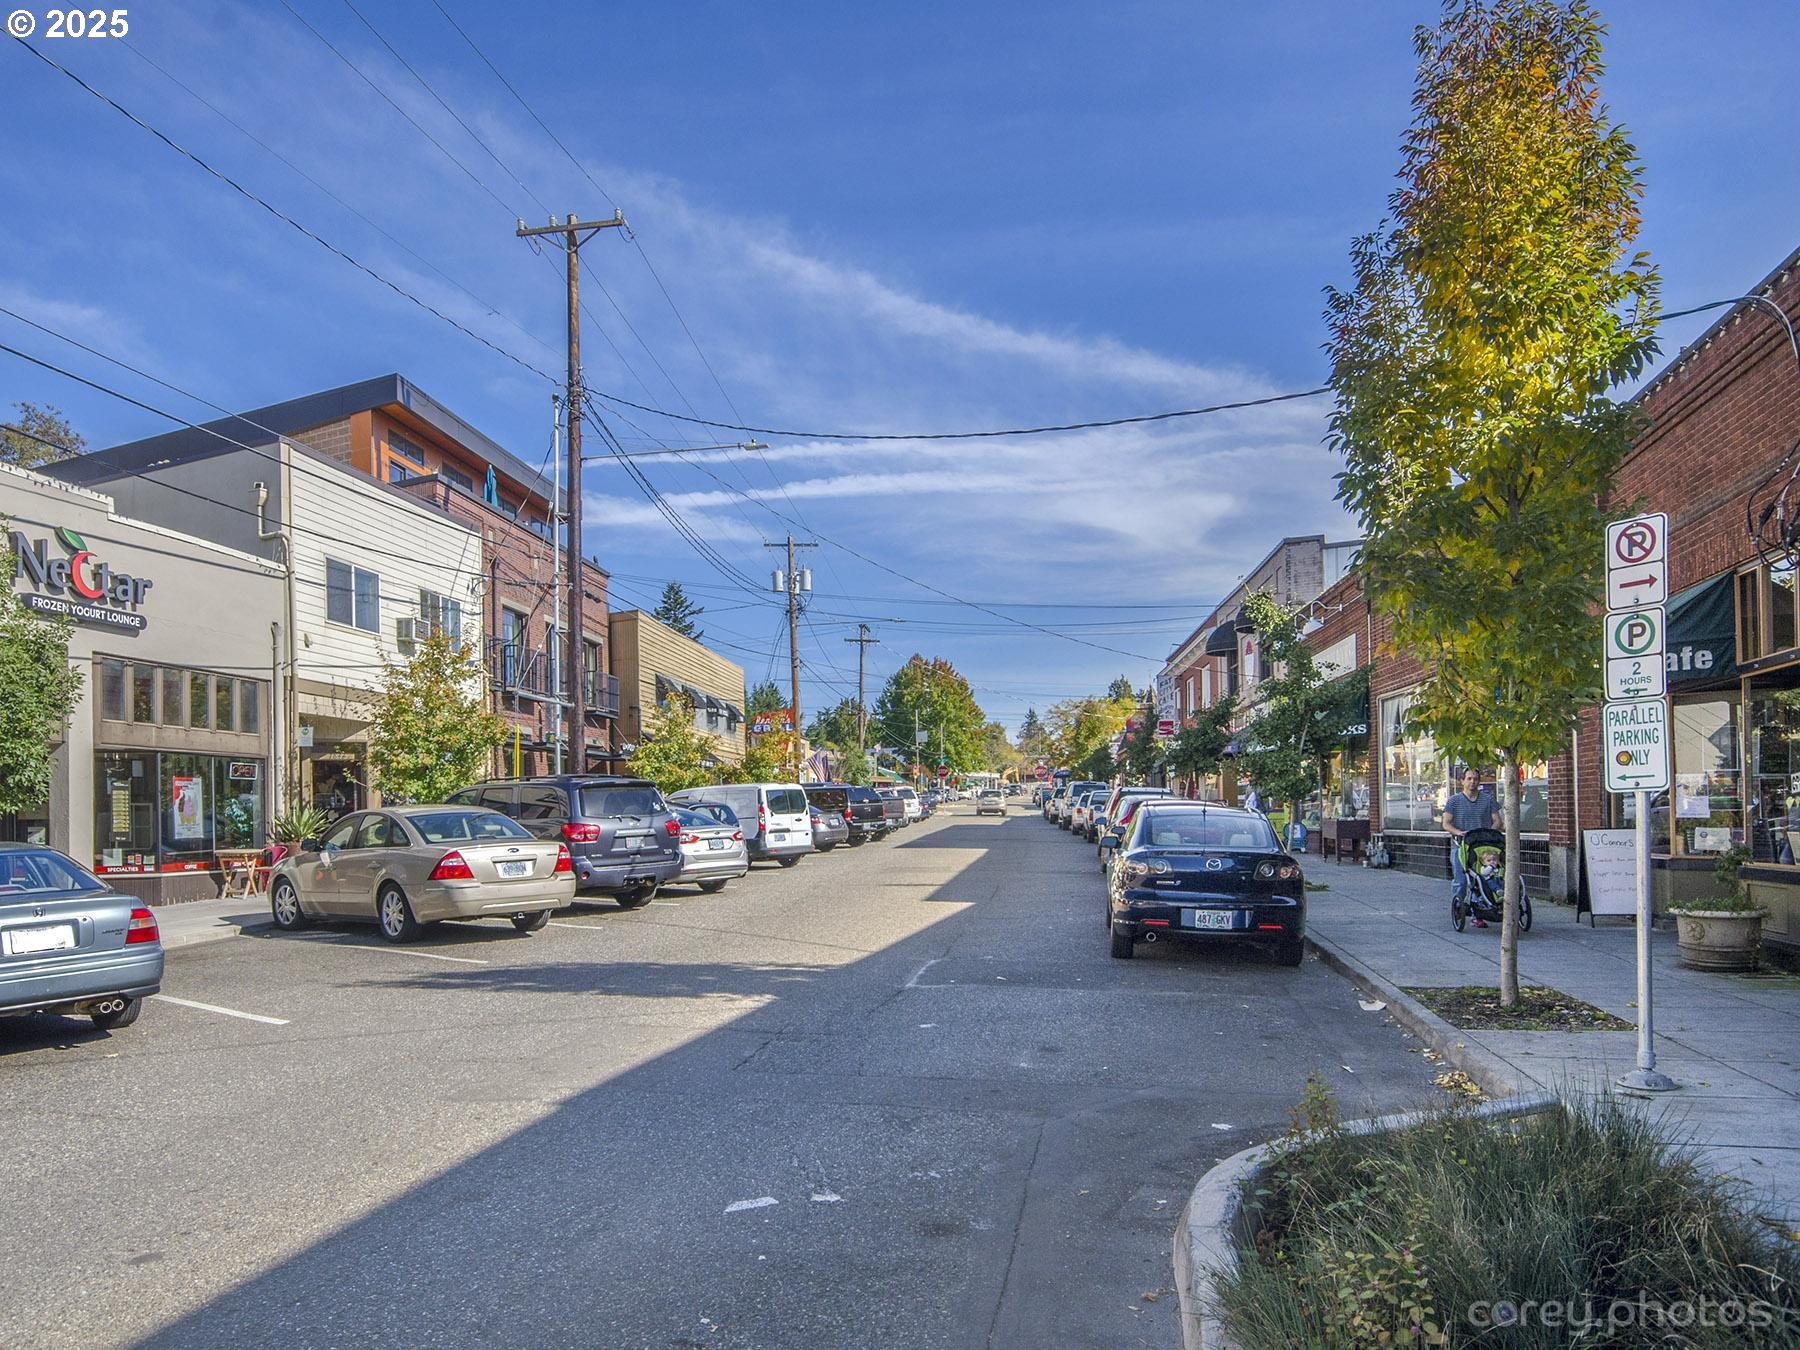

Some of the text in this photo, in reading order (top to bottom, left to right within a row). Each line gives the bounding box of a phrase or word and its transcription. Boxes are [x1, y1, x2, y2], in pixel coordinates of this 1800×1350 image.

[32, 596, 141, 627] FROZEN YOGURT LOUNGE
[1627, 622, 1647, 648] P
[1632, 661, 1642, 676] 2
[1665, 646, 1713, 672] afe
[1619, 676, 1653, 687] HOURS
[1608, 706, 1663, 728] PARALLEL
[1613, 727, 1660, 747] PARKING
[1616, 749, 1650, 767] NLY
